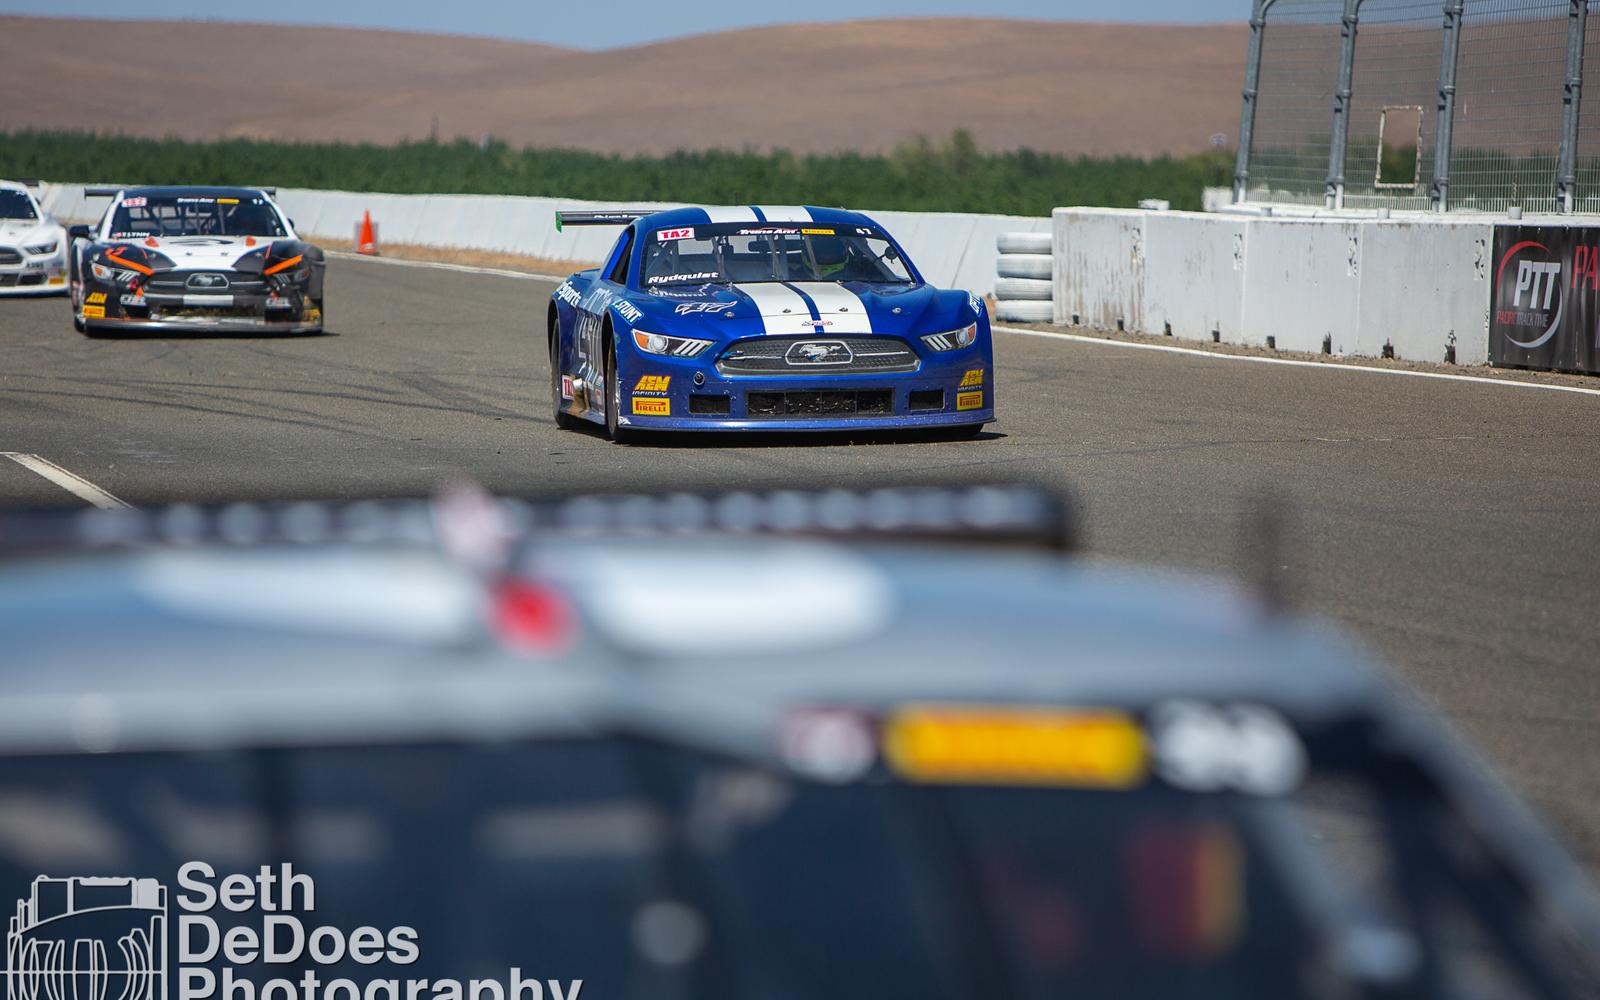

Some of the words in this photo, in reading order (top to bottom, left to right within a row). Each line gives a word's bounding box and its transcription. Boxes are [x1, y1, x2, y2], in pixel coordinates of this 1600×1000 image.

[661, 229, 691, 239] TA2
[1571, 245, 1600, 290] PA
[648, 272, 719, 285] Rydquist
[1513, 260, 1561, 310] PTT
[634, 375, 671, 392] AEM
[635, 400, 667, 413] PIRELLI
